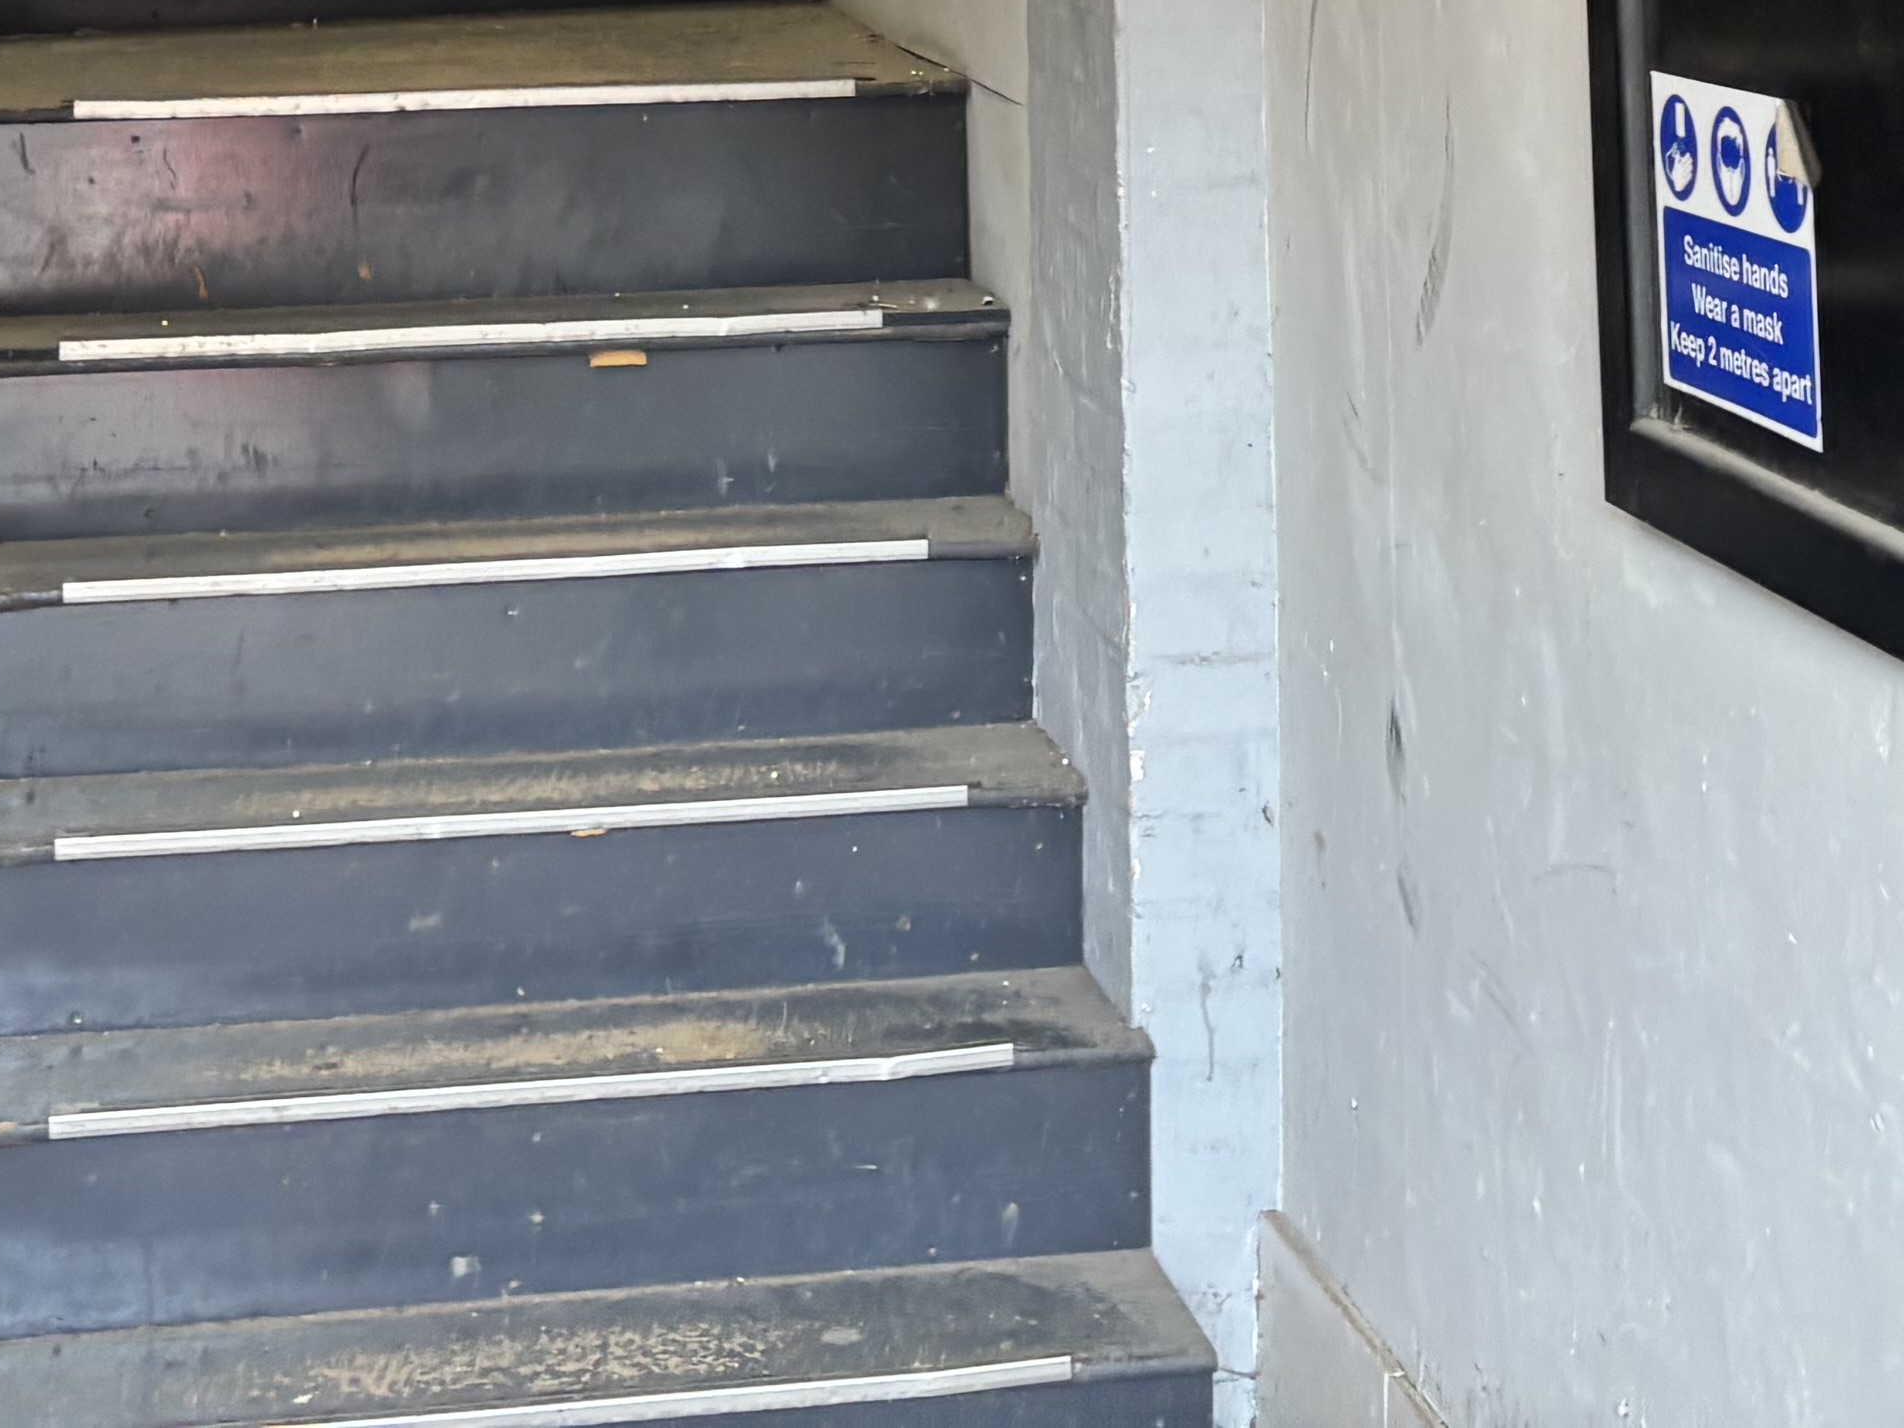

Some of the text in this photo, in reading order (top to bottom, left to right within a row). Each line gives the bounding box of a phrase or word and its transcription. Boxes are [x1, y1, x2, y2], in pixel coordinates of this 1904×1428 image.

[1683, 233, 1789, 299] Sanitise hands
[1691, 282, 1784, 346] Wear a mask
[1670, 321, 1813, 406] Keep 2 metres apart
